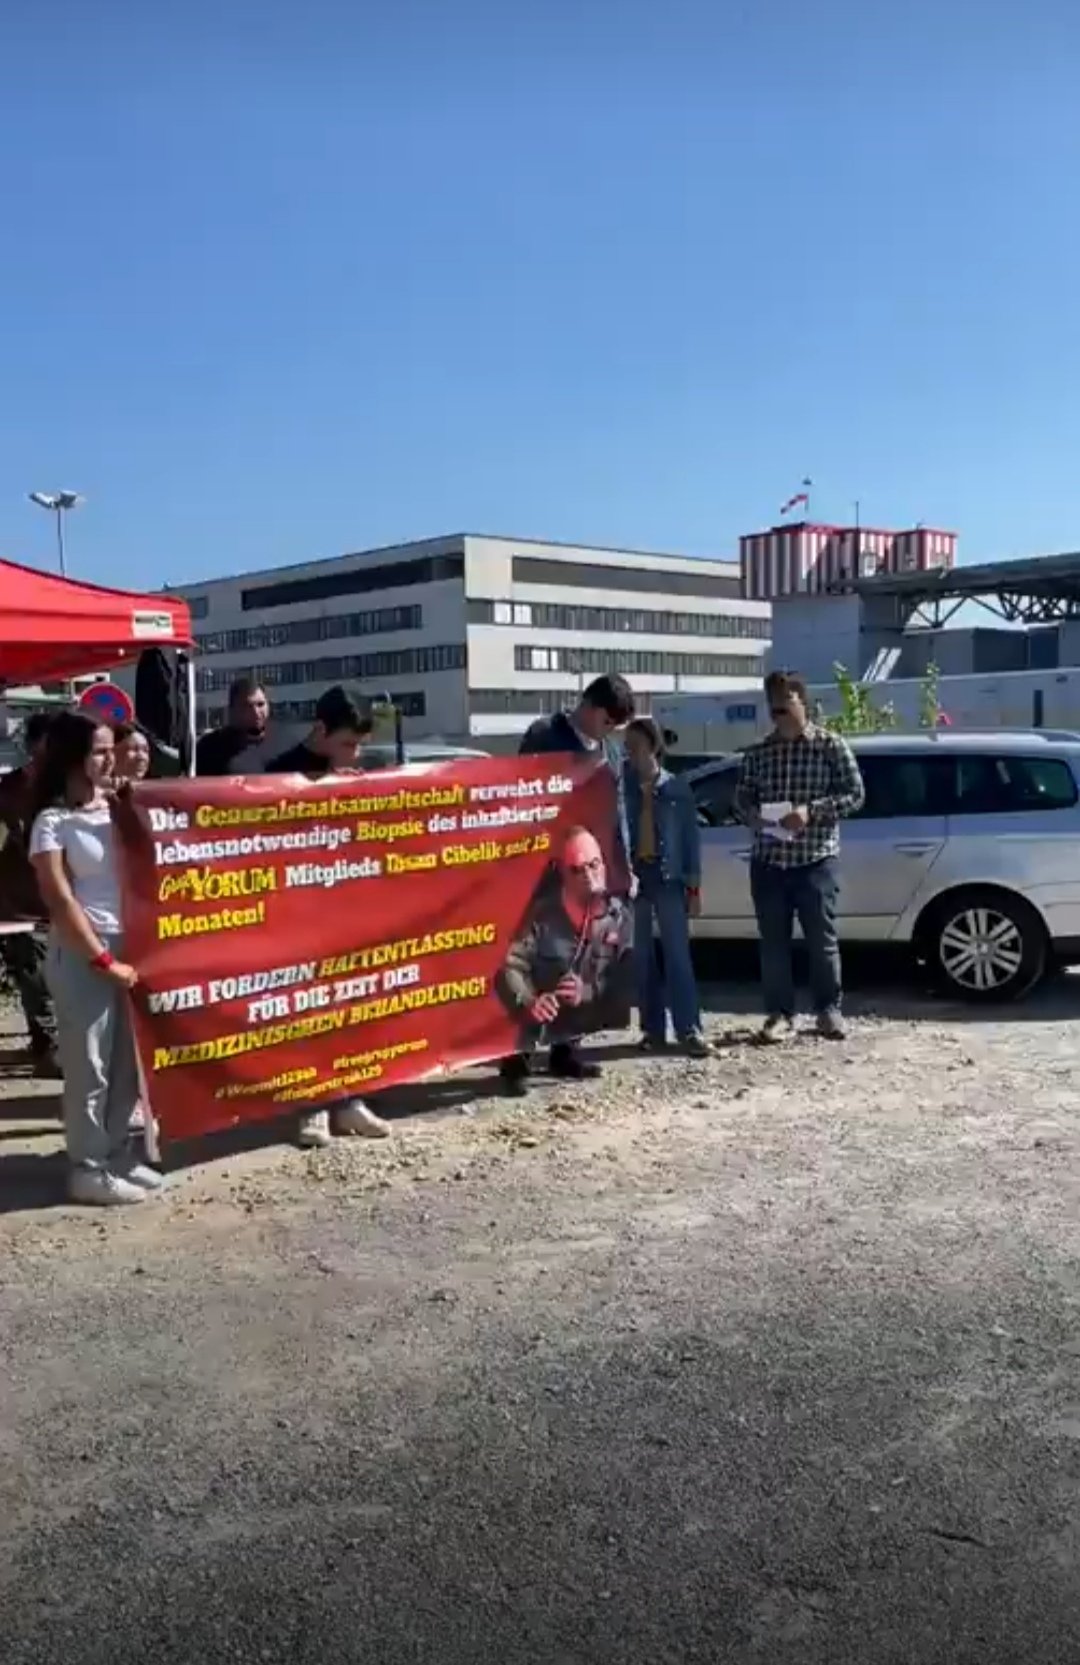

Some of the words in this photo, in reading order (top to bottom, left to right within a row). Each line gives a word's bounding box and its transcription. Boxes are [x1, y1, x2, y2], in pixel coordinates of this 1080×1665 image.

[148, 808, 188, 832] Die
[547, 775, 574, 794] die
[154, 825, 352, 865] lebensnotwendige
[356, 819, 425, 842] Biopsie
[428, 813, 458, 832] des
[186, 865, 278, 901] YORUM
[285, 856, 382, 888] Mitglieds
[157, 901, 266, 940] Monaten!
[149, 984, 205, 1014] WIR
[208, 961, 318, 1004] FORDERN
[319, 923, 497, 979] HAFTENTLASSUNG
[247, 993, 290, 1023] FÜR
[293, 984, 331, 1012] DIE
[333, 972, 380, 1001] ZEIT
[383, 963, 421, 991] DER
[153, 1009, 346, 1071] MEDIZINISCHEN
[348, 976, 486, 1025] BEHANDLUNG!
